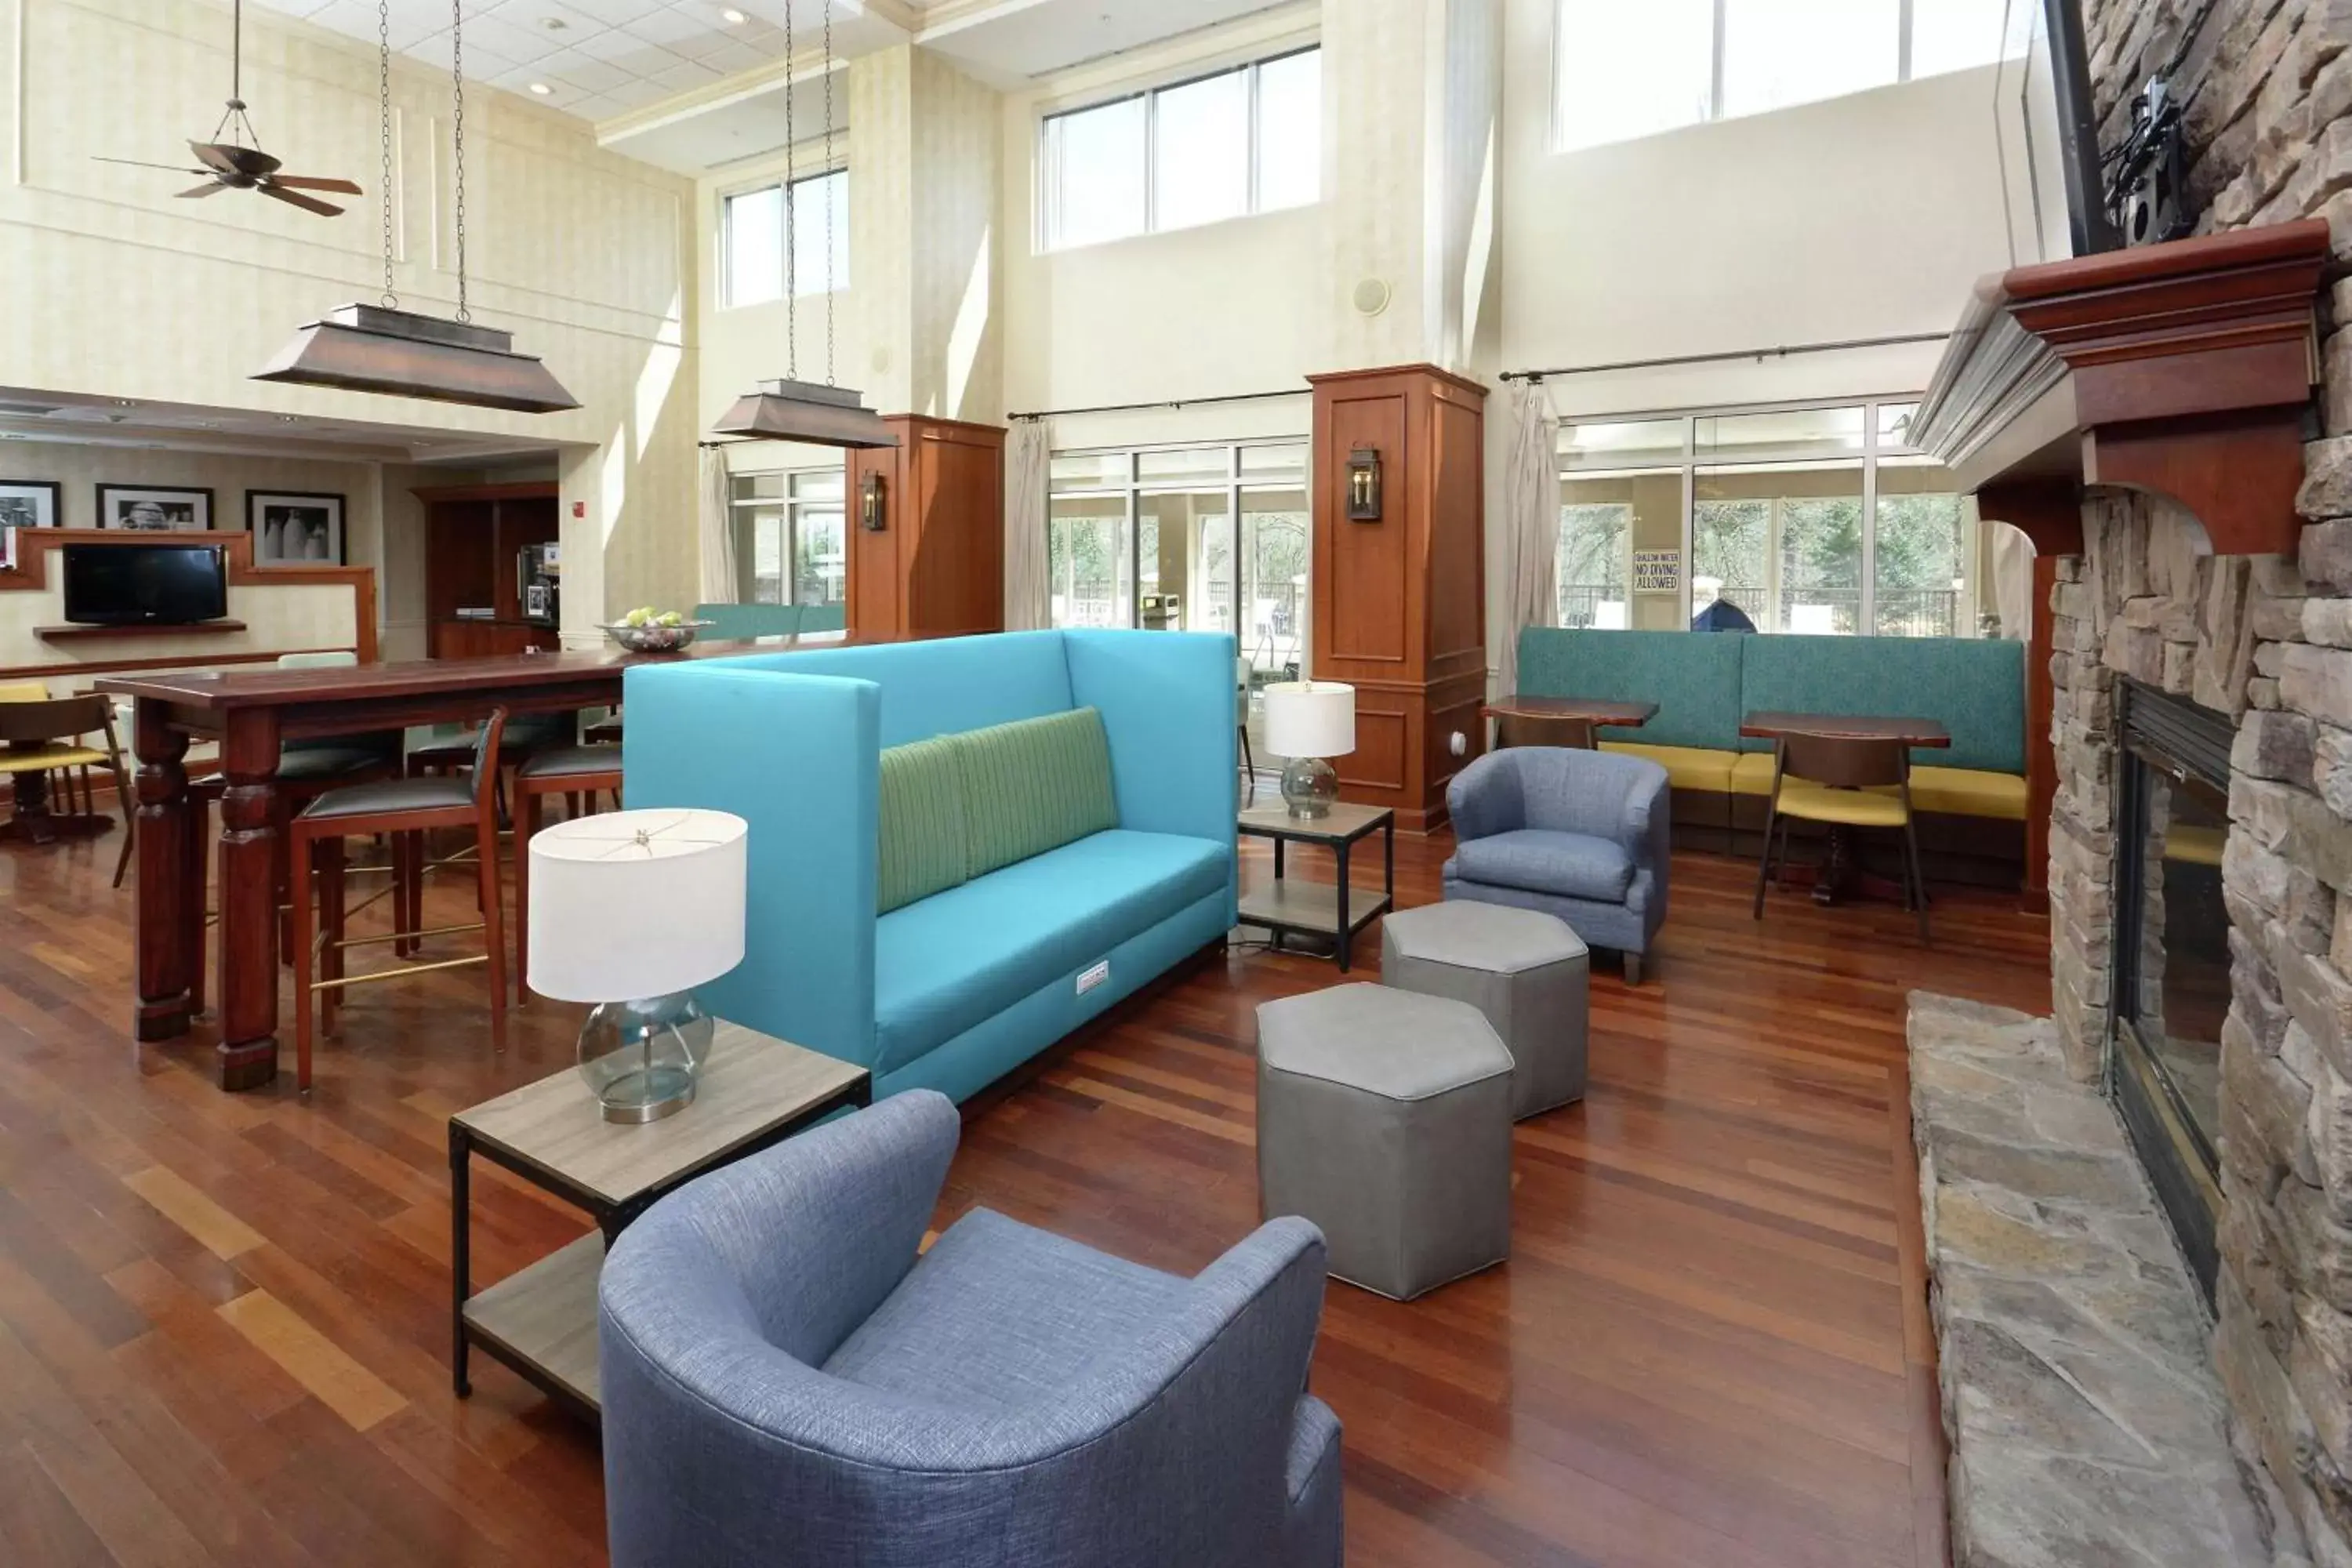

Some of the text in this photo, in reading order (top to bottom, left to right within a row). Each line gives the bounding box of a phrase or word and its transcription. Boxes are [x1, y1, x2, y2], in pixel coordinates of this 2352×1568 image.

[1636, 564, 1679, 575] NO DIVING
[1636, 576, 1677, 588] ALLOWED
